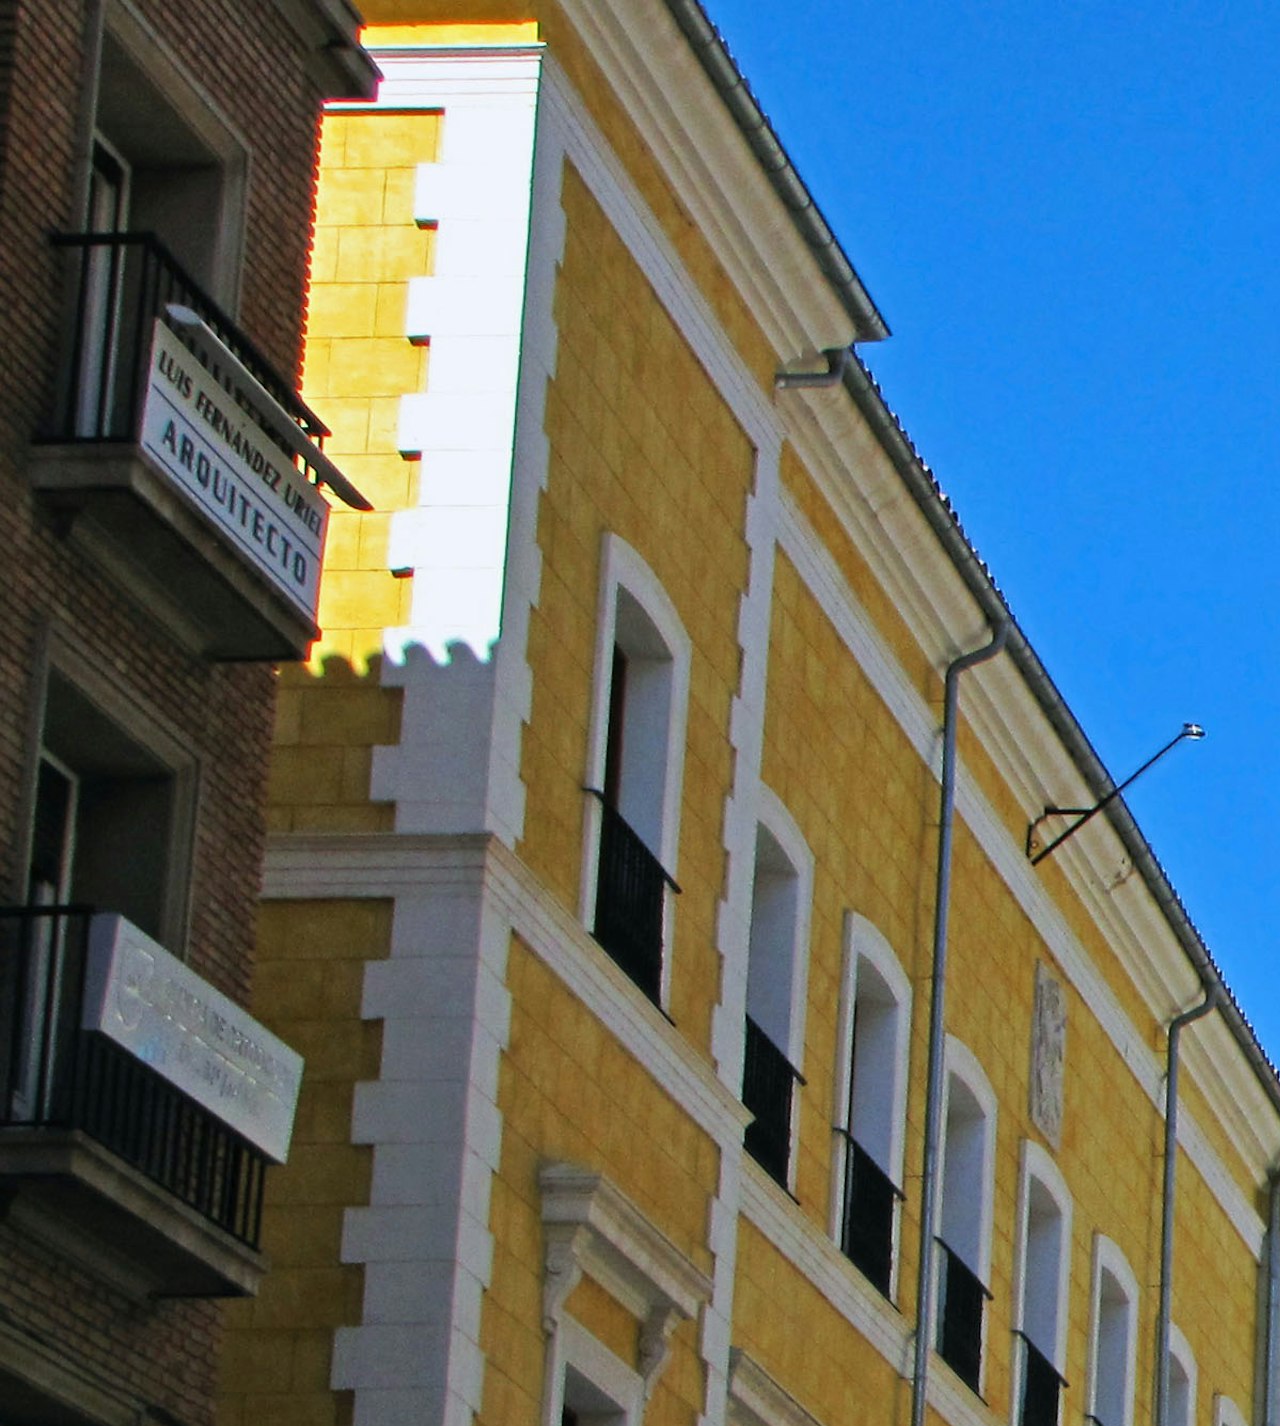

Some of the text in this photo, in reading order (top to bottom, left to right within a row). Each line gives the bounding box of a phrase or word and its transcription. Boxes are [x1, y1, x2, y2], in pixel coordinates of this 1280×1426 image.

[159, 350, 193, 400] LUIS
[285, 483, 322, 538] URIEL
[162, 418, 307, 586] ARQUITECTO
